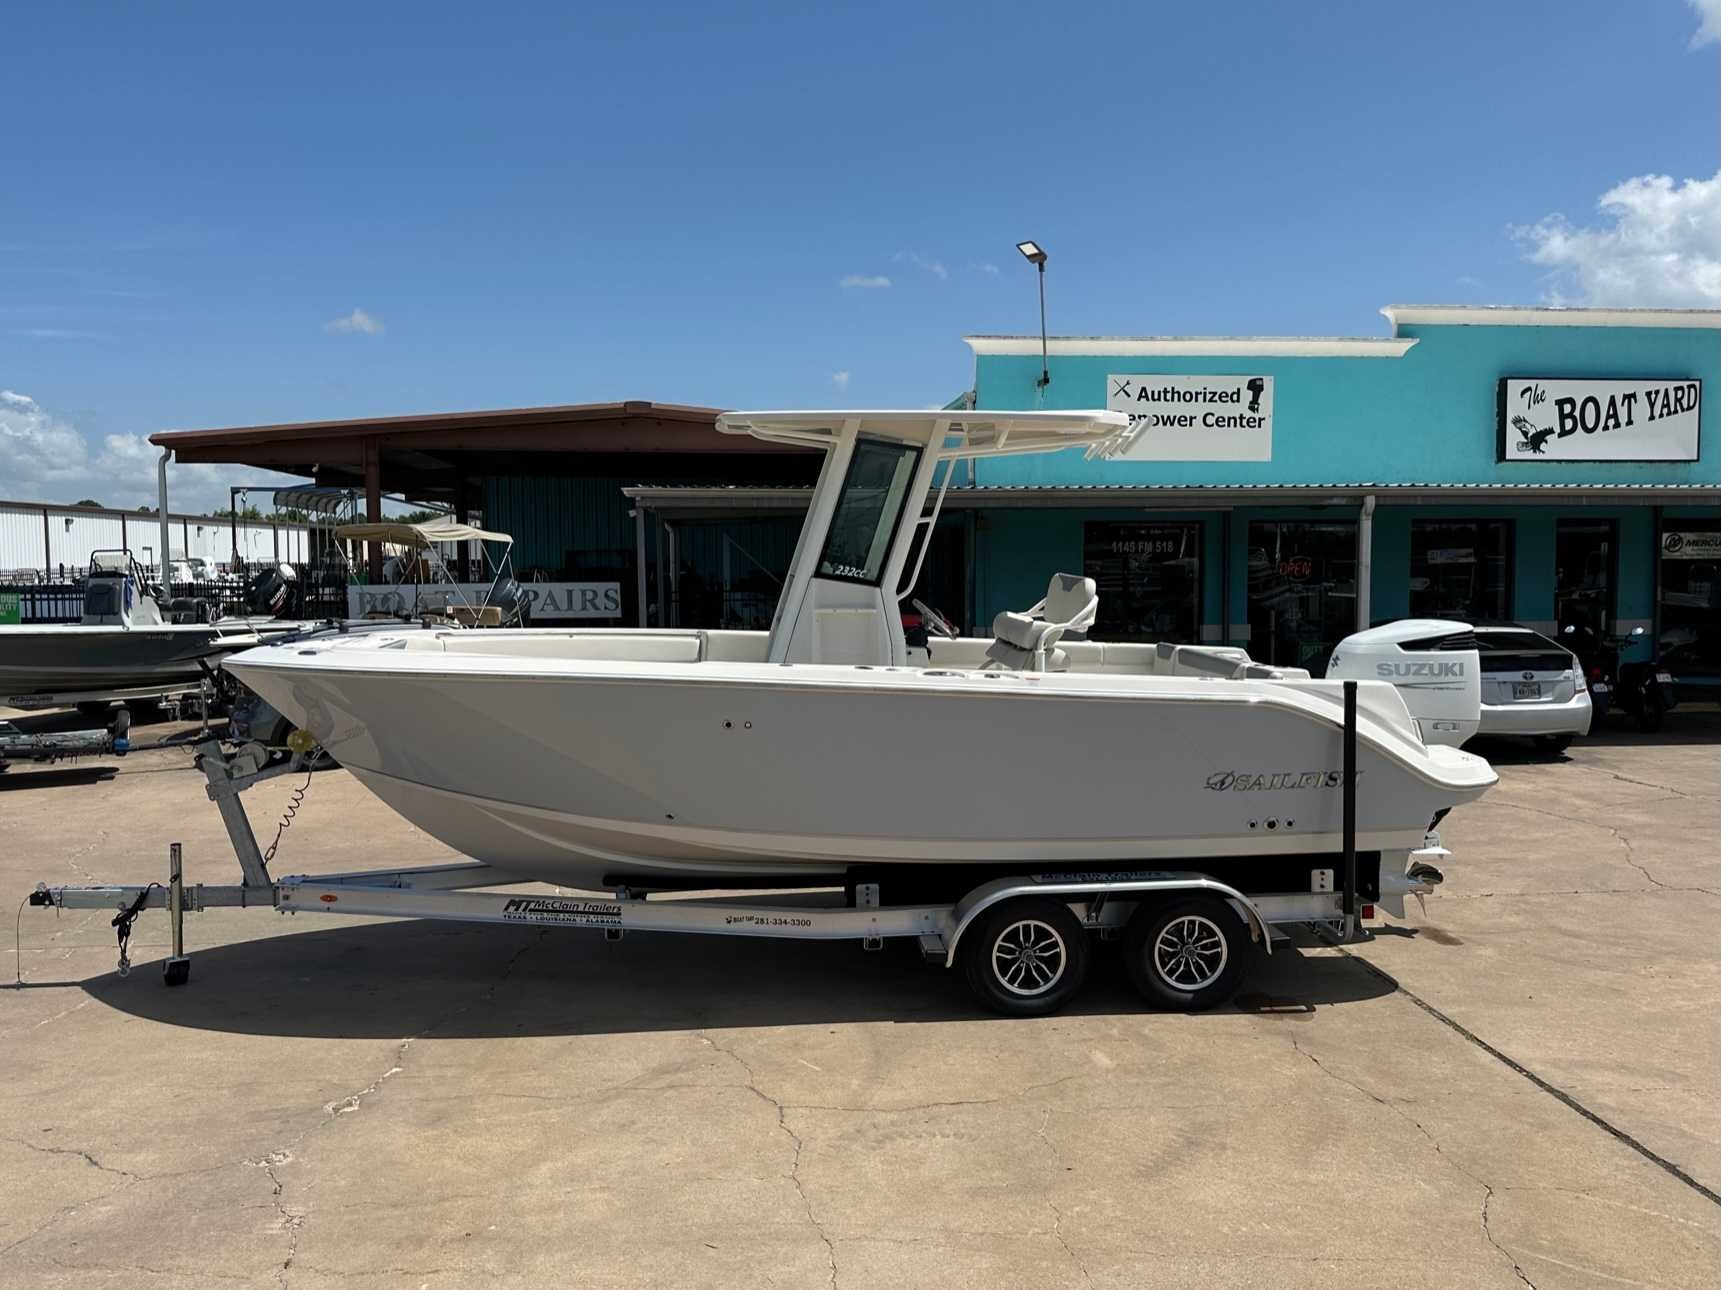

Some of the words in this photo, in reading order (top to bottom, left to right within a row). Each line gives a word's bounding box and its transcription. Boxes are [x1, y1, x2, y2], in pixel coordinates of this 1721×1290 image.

[1136, 386, 1241, 404] Authorized
[1520, 383, 1547, 411] The
[1554, 391, 1638, 439] BOAT
[1645, 383, 1699, 422] YARD
[1202, 412, 1266, 429] Center
[1155, 541, 1174, 553] 518
[1280, 561, 1313, 577] OPEN
[473, 588, 621, 617] RPAIRS
[1376, 662, 1465, 677] SUZUKI
[1232, 769, 1365, 792] SAILFIS
[533, 900, 580, 911] McClain
[582, 902, 622, 913] Trailers
